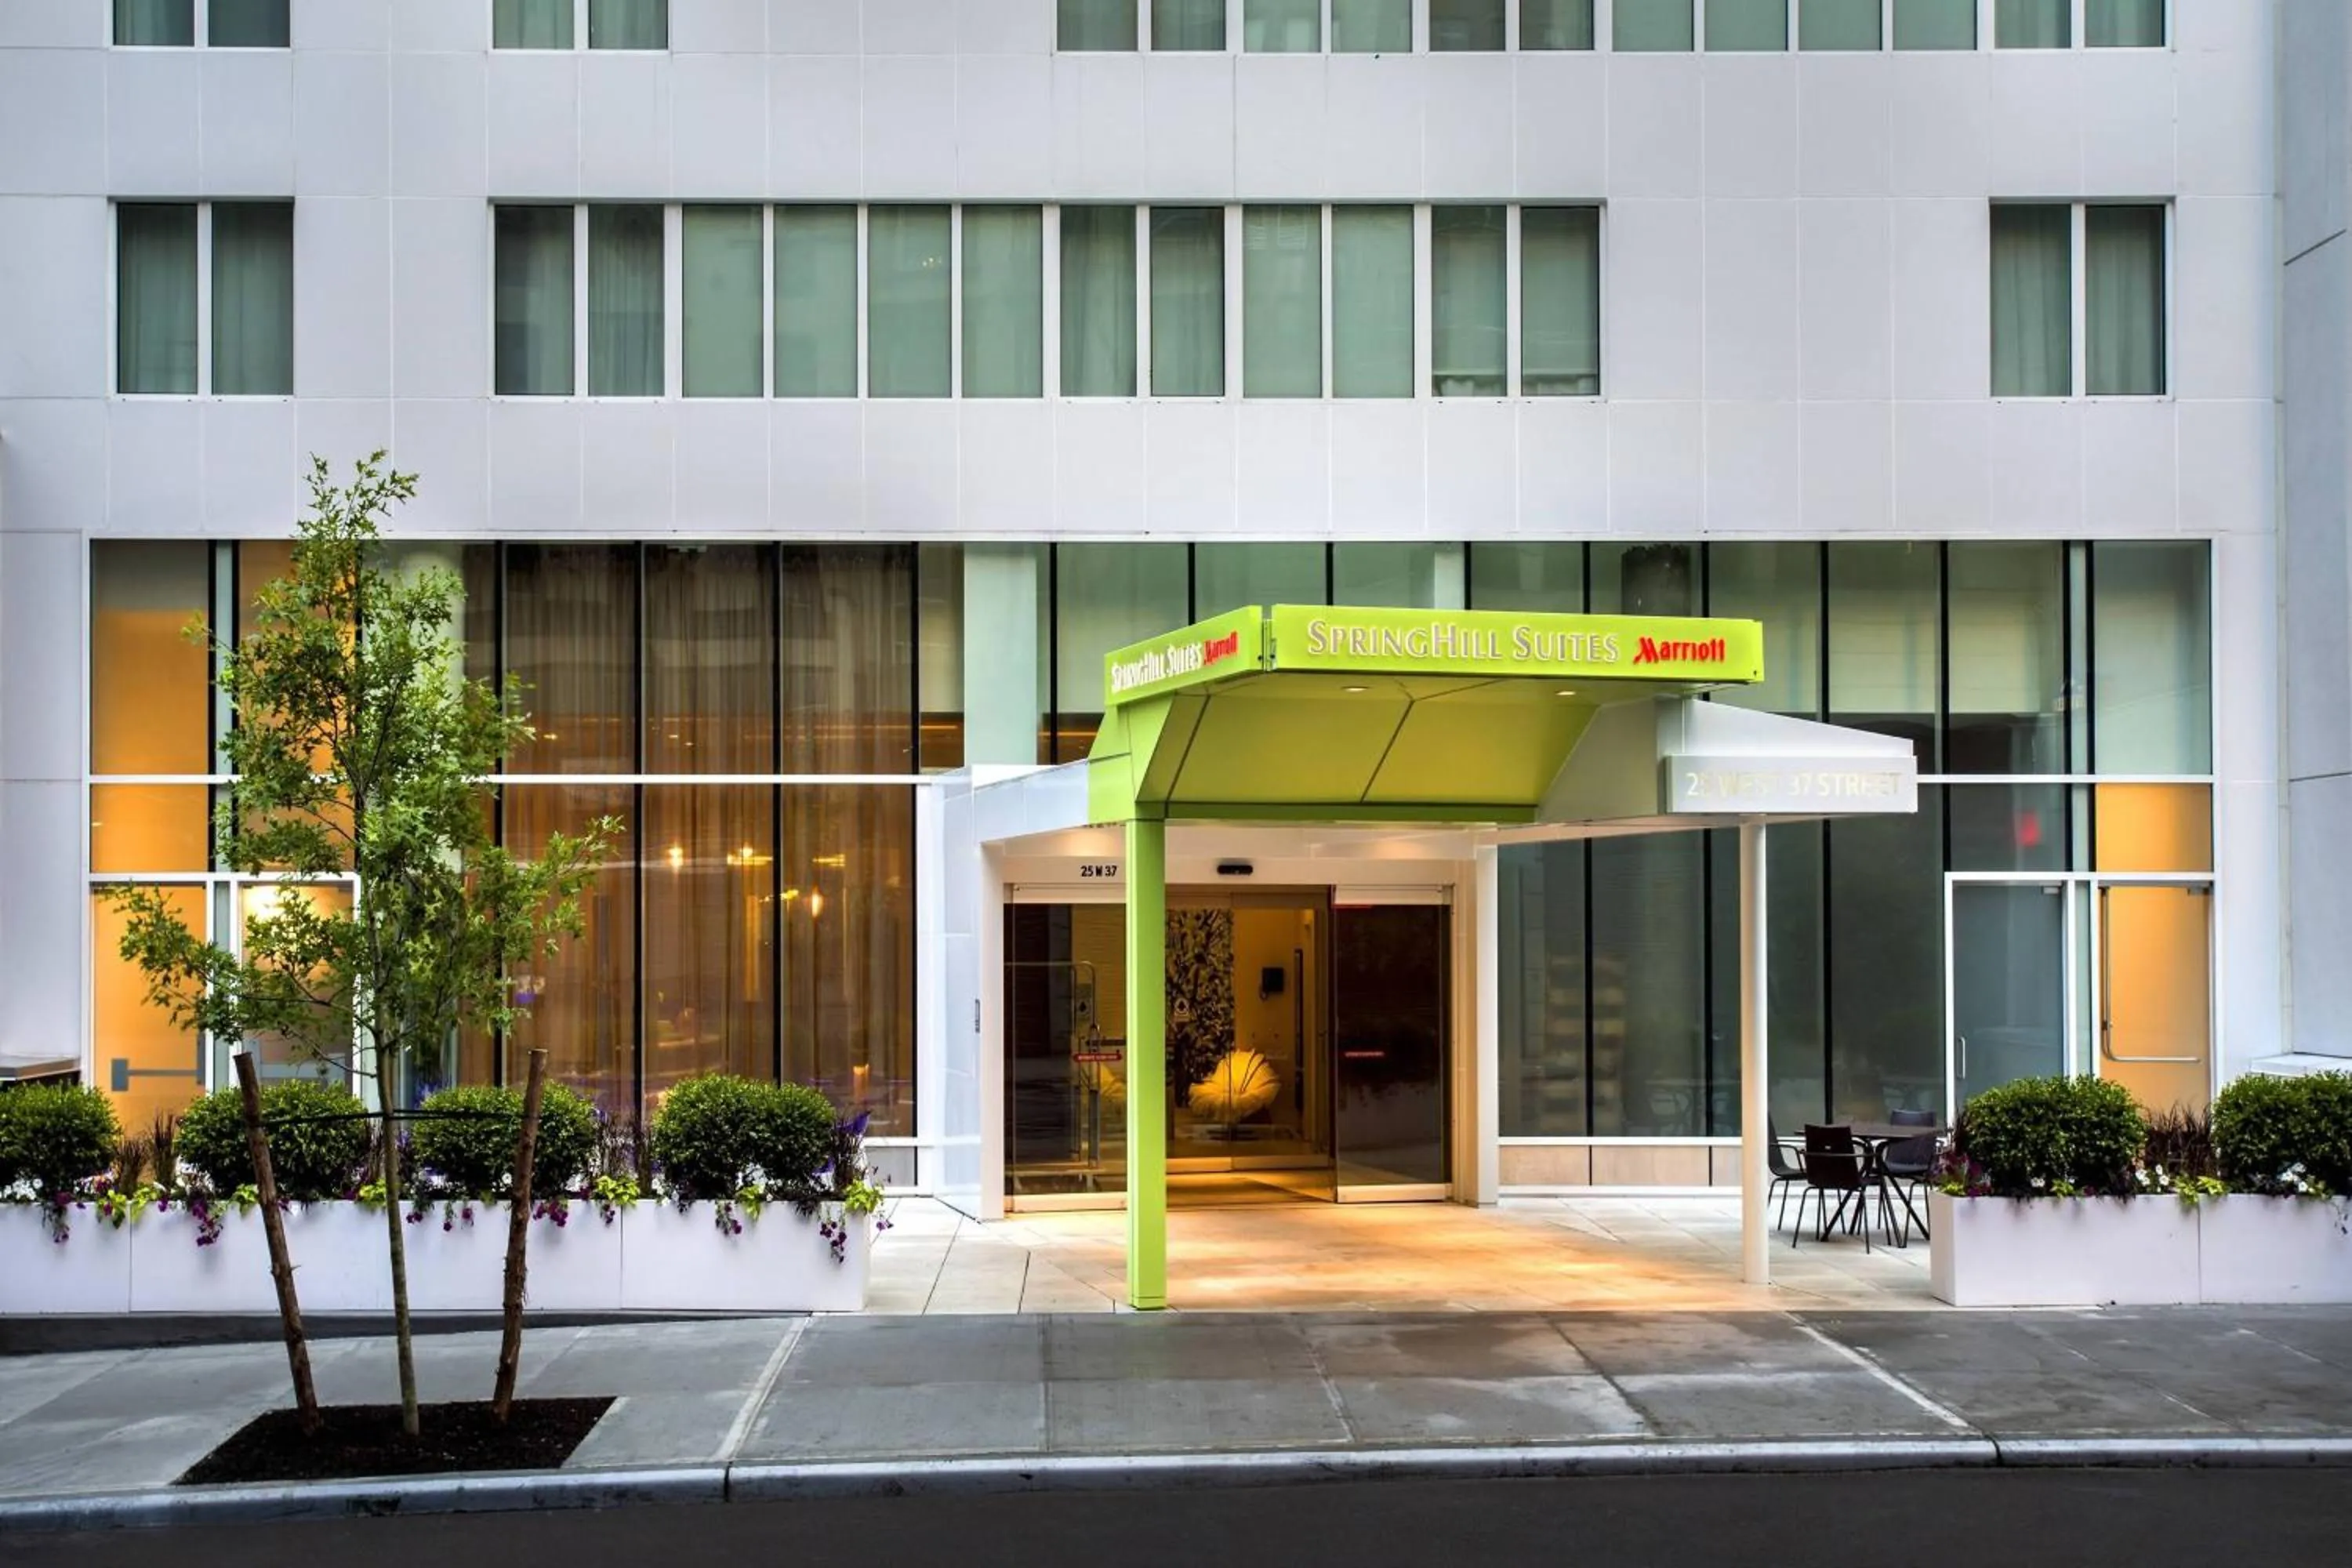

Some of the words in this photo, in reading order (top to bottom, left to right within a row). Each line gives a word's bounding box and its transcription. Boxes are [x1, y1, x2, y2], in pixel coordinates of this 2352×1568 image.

[1512, 626, 1620, 664] SUITES
[1633, 636, 1725, 665] Marriott
[1788, 771, 1813, 797] 37
[1817, 771, 1903, 797] STREET
[1080, 865, 1094, 877] 25
[1095, 865, 1103, 877] W
[1105, 865, 1117, 877] 37
